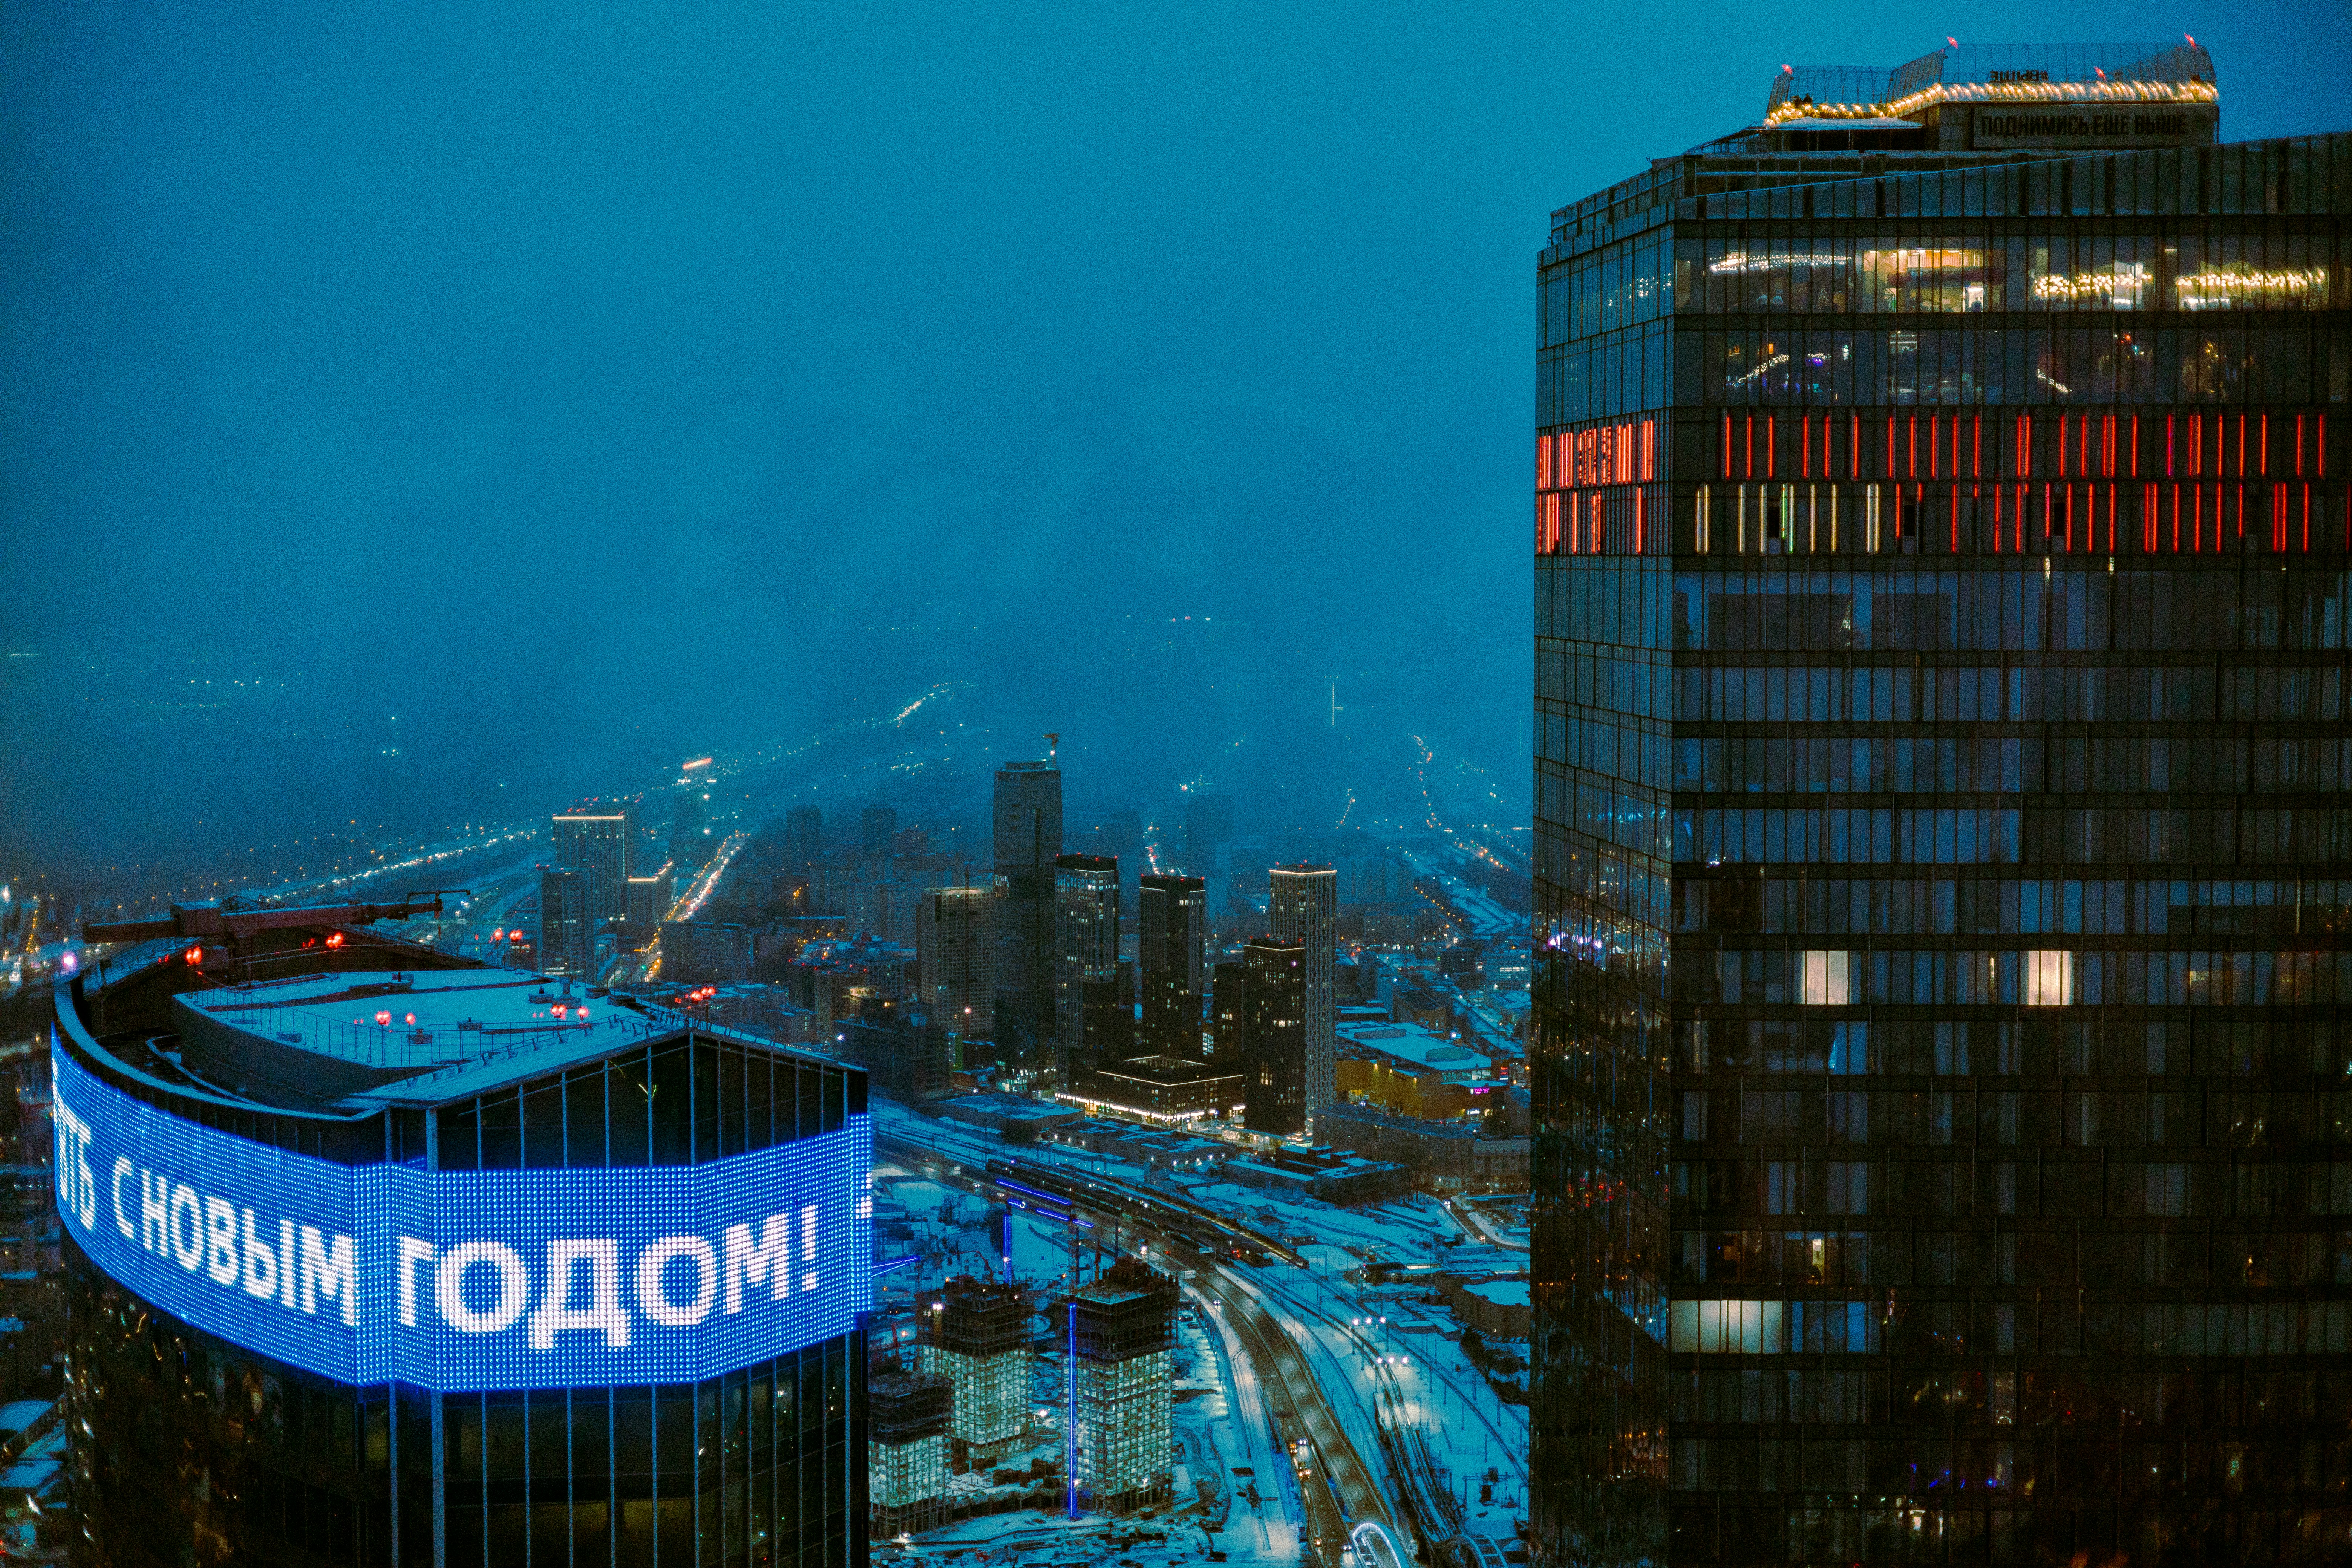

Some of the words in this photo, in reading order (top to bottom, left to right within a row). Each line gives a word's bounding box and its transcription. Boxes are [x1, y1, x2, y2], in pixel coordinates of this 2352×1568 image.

[1981, 115, 2089, 138] ПОДНИМИСЬ
[2093, 115, 2130, 137] ЕЩЕ
[2134, 114, 2187, 135] ВЫШЕ
[113, 1156, 134, 1239] С
[142, 1168, 355, 1326] НОВЫМ
[397, 1204, 818, 1350] ГОДОМ!
